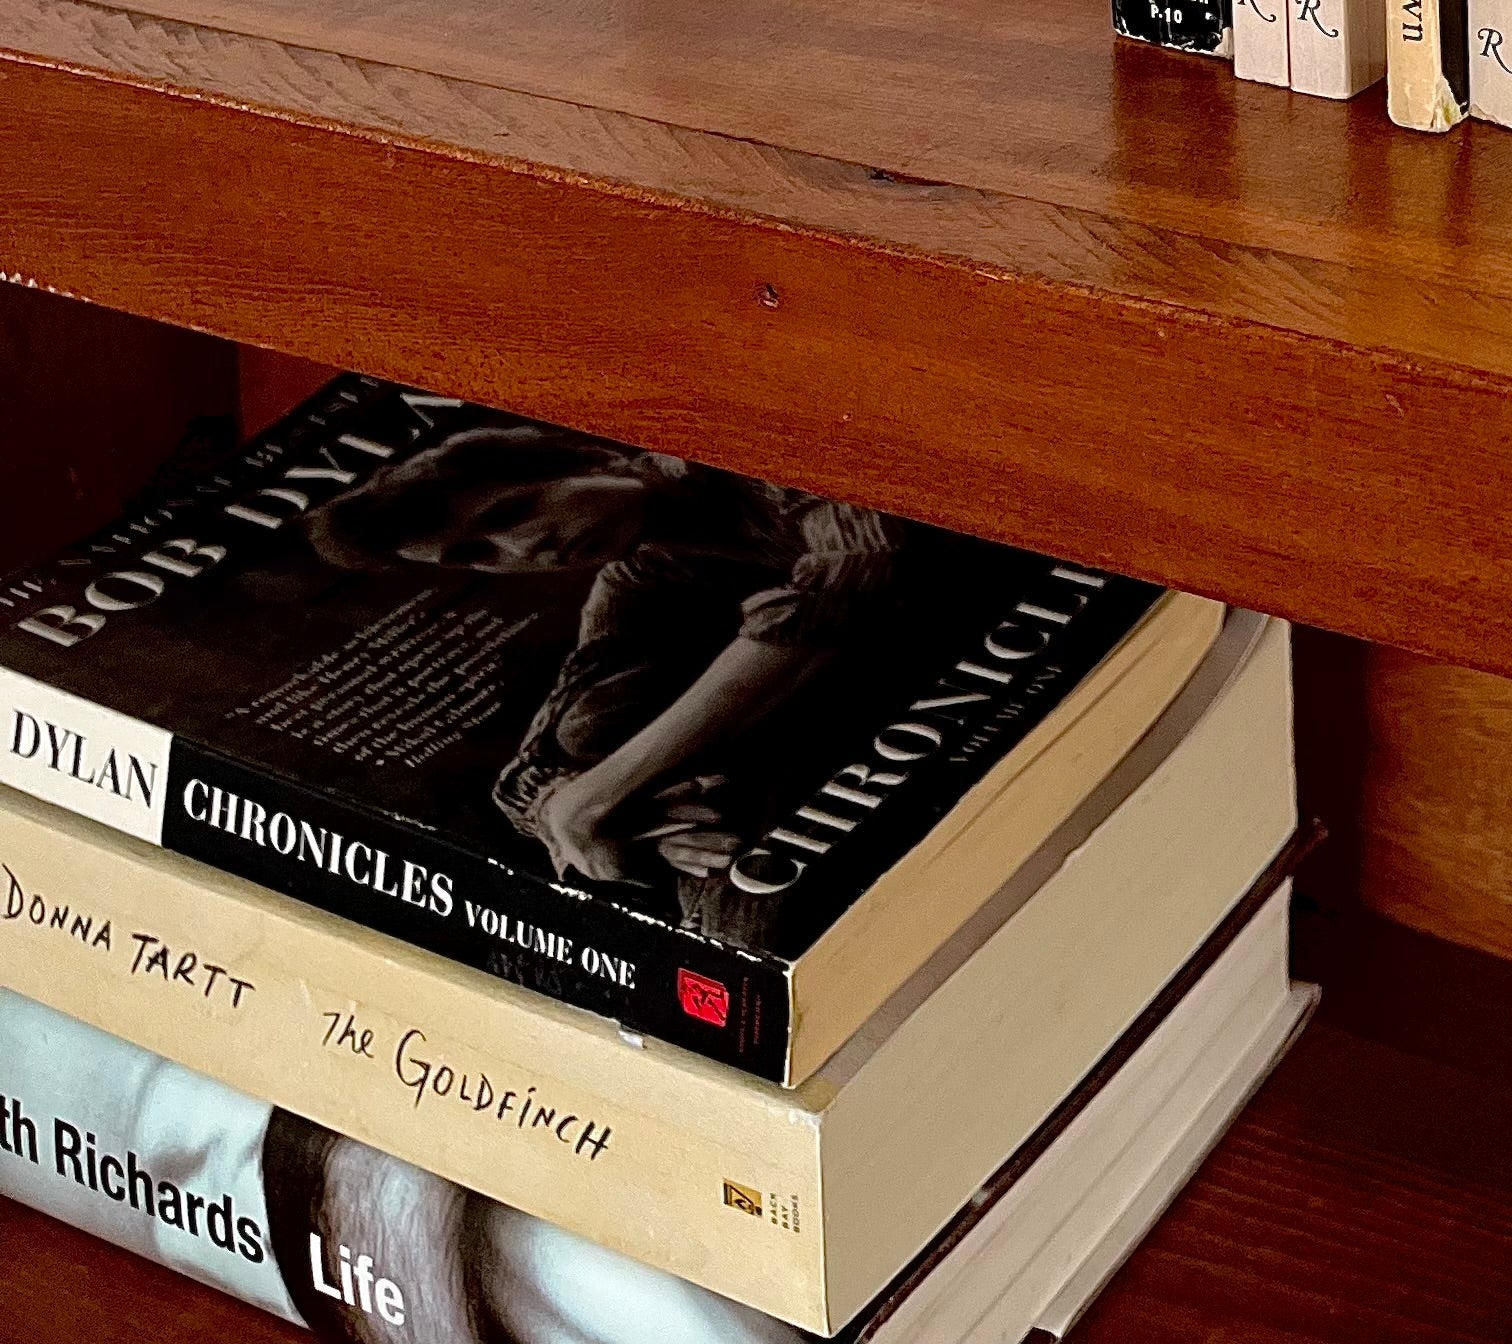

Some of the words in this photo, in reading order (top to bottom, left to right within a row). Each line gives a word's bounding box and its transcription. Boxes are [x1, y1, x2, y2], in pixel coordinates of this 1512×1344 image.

[17, 538, 227, 647] BOB
[224, 391, 465, 530] DYLA
[1, 863, 112, 952] DONNA
[131, 933, 257, 1009] TARTT
[322, 1011, 375, 1059] The
[10, 709, 158, 809] DYLAN
[183, 778, 454, 917] CHRONICLES
[464, 899, 574, 965] VOLUME
[581, 946, 636, 990] ONE
[54, 1116, 266, 1265] Richards
[309, 1231, 406, 1326] Life
